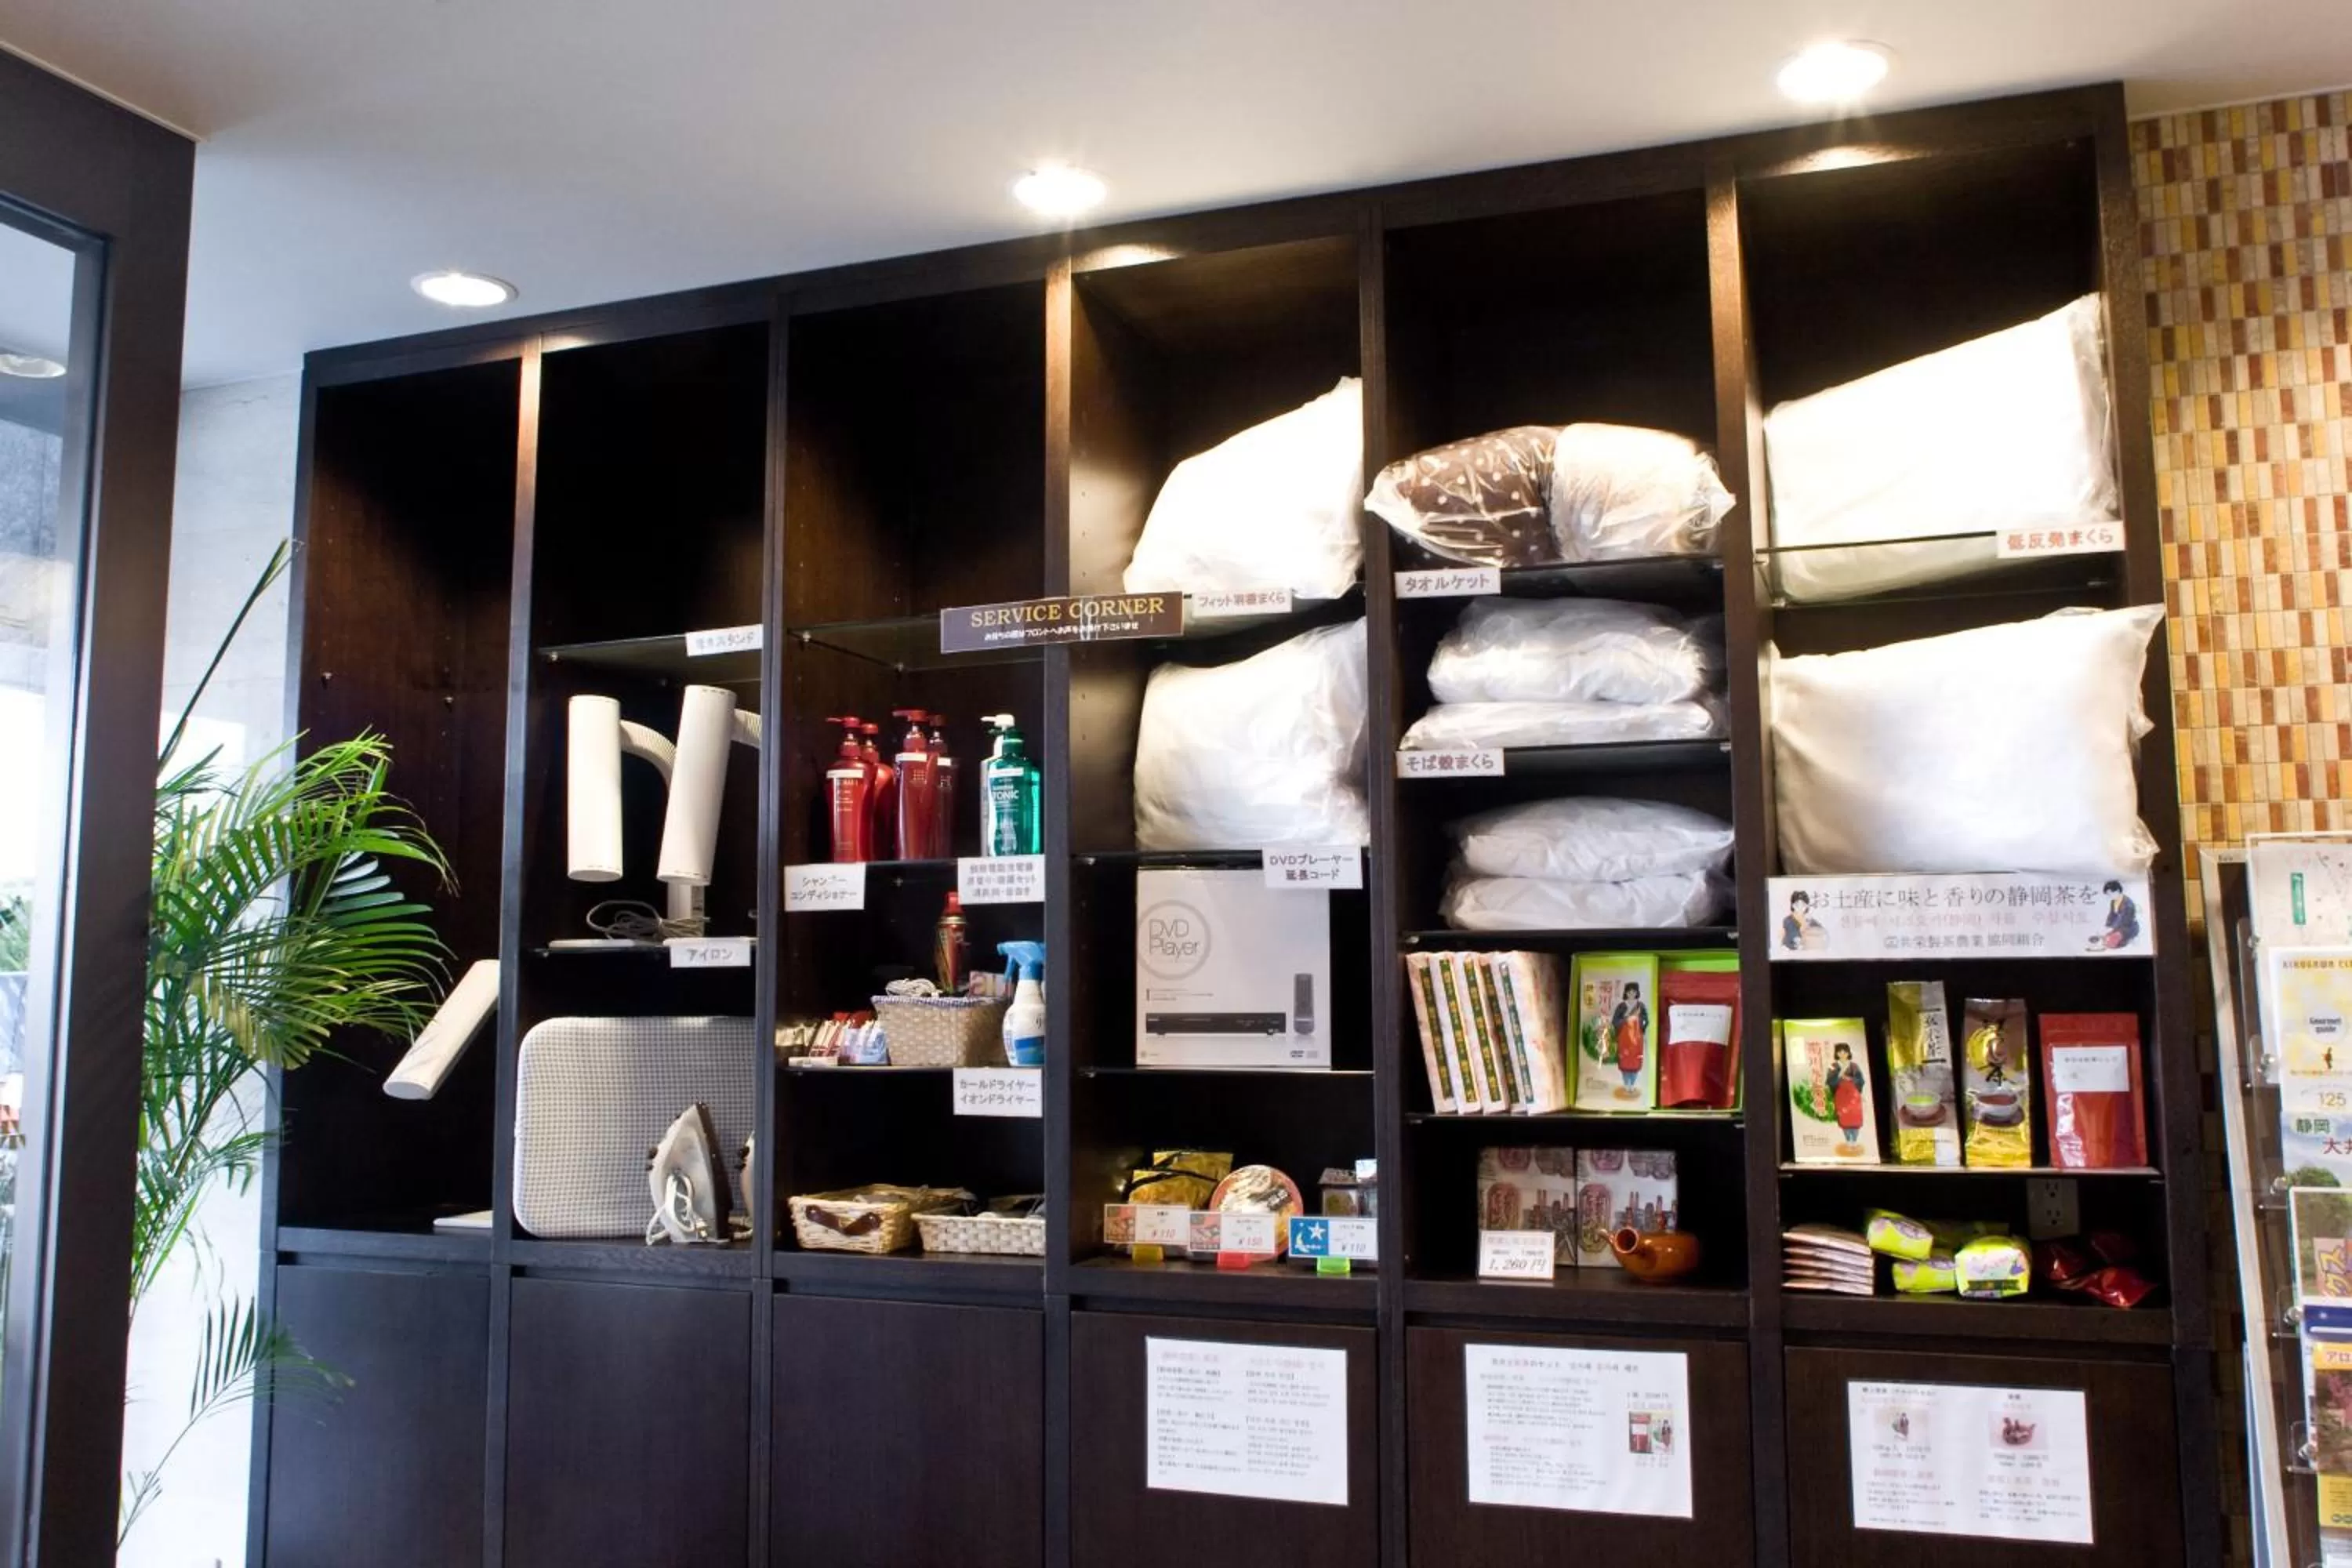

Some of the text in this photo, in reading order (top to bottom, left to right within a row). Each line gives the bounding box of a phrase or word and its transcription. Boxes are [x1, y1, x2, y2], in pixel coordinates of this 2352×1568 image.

[2007, 528, 2113, 550] 低反発まくら
[1405, 573, 1490, 591] タオルケット
[971, 597, 1165, 628] SERVICE CORNER
[1406, 753, 1494, 771] そば殻まくら
[1269, 852, 1354, 866] DVDプレーヤー
[1149, 918, 1189, 938] DVD
[686, 949, 733, 961] アイロン
[1149, 937, 1199, 960] Player
[2318, 1092, 2347, 1106] 125
[2296, 1117, 2331, 1135] 静岡
